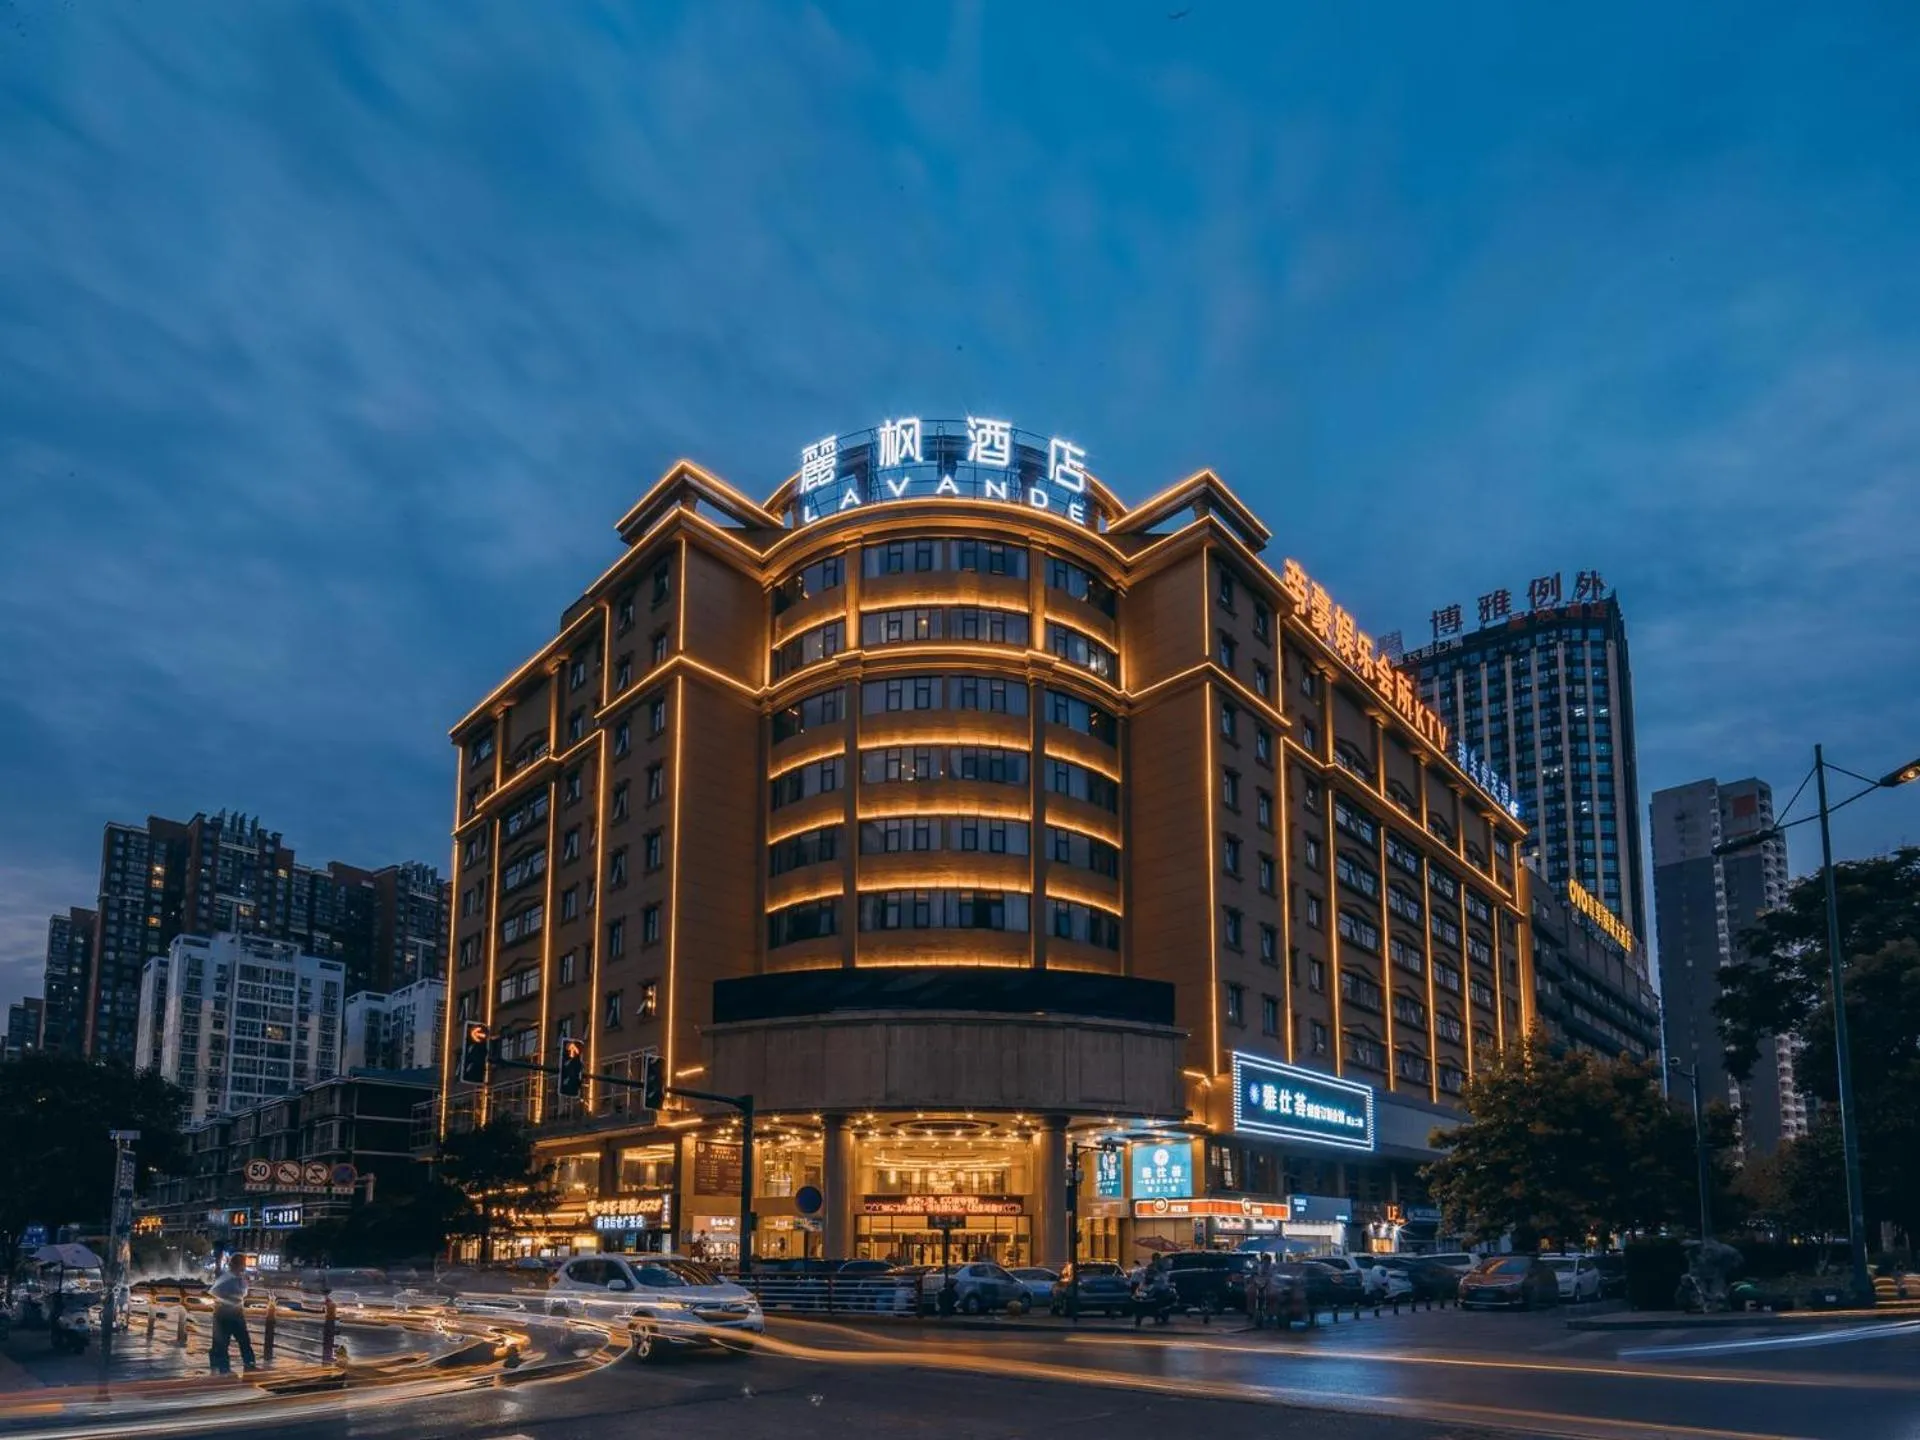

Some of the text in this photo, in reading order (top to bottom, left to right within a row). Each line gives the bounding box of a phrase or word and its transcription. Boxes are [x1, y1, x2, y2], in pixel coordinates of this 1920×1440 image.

[804, 475, 1086, 525] LAVANDE
[1430, 569, 1607, 634] 博雅例外
[251, 1164, 267, 1177] 50
